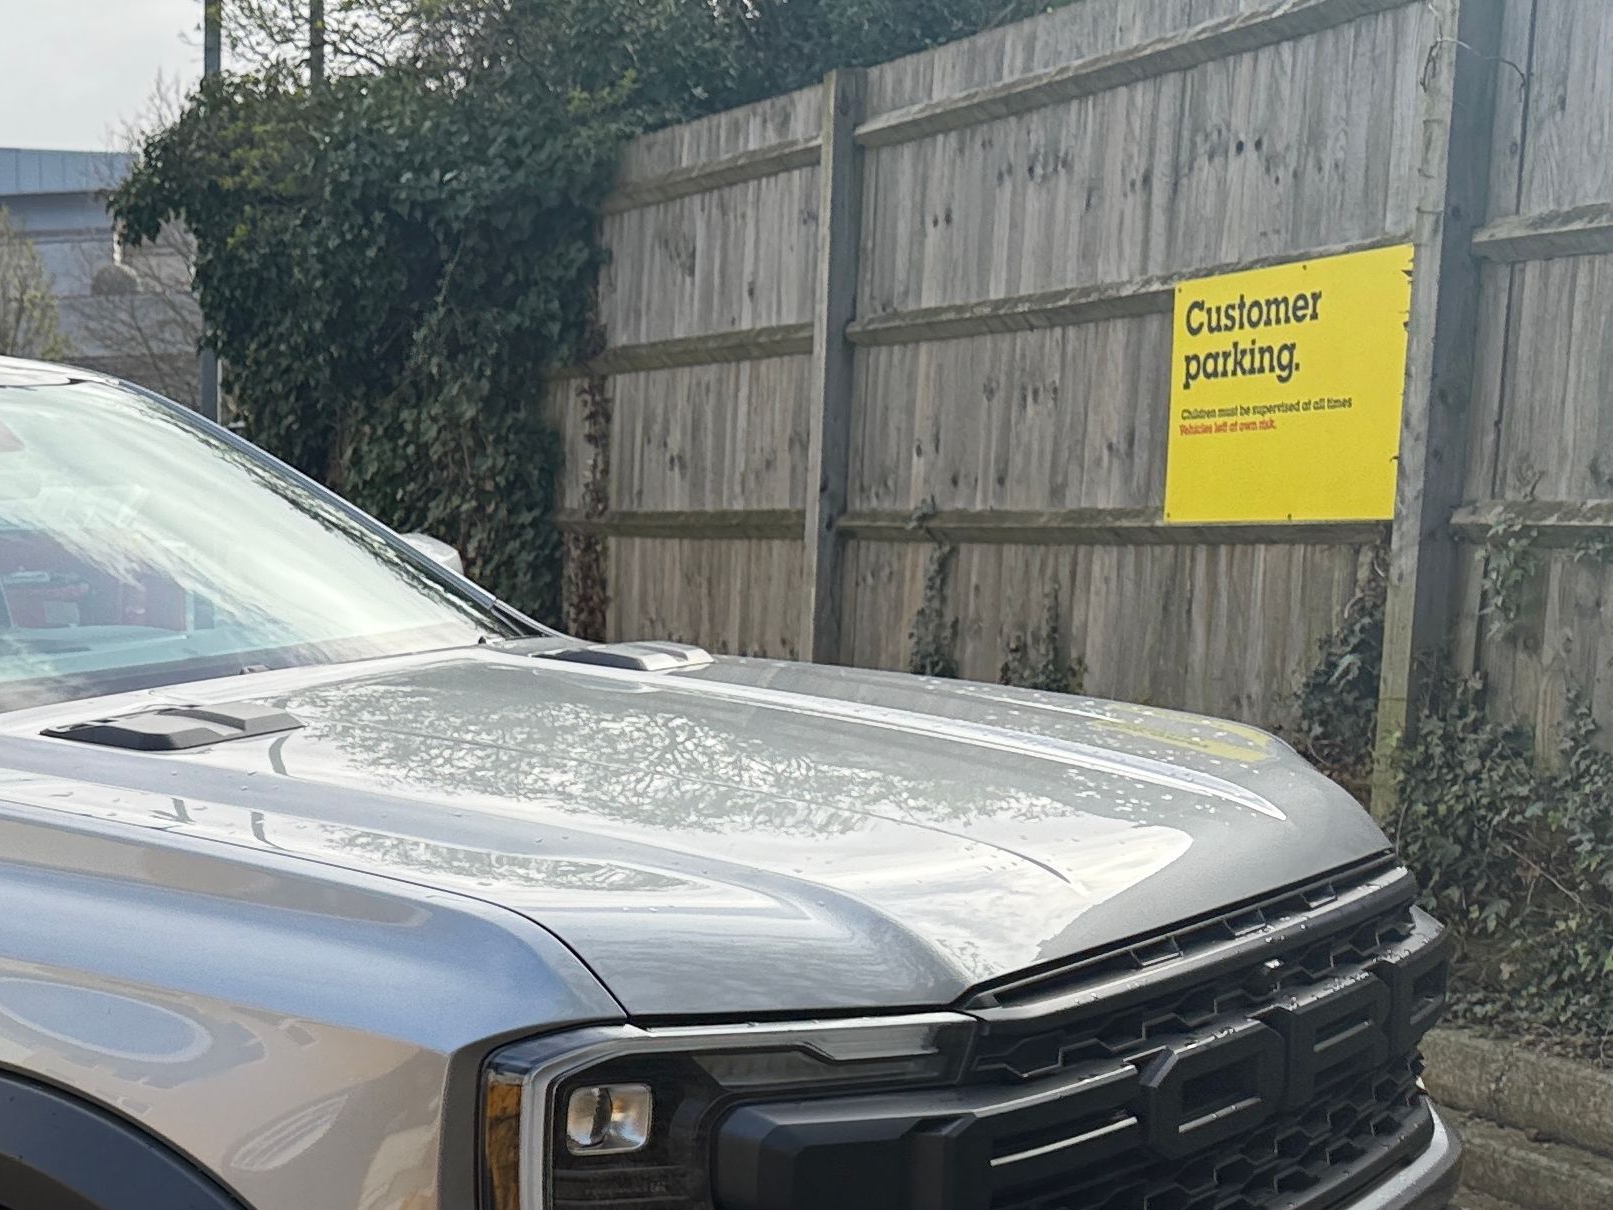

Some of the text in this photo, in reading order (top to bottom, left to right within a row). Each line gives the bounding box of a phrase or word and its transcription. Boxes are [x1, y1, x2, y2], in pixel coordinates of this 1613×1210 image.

[1185, 290, 1323, 337] Customer
[1182, 339, 1301, 390] parking.
[1180, 407, 1217, 421] Children
[1218, 405, 1239, 418] must
[1239, 404, 1251, 417] be
[1252, 400, 1301, 417] supervised
[1301, 399, 1312, 412] at
[1313, 397, 1326, 411] all
[1178, 421, 1213, 436] Vehicles
[1238, 421, 1258, 432] own
